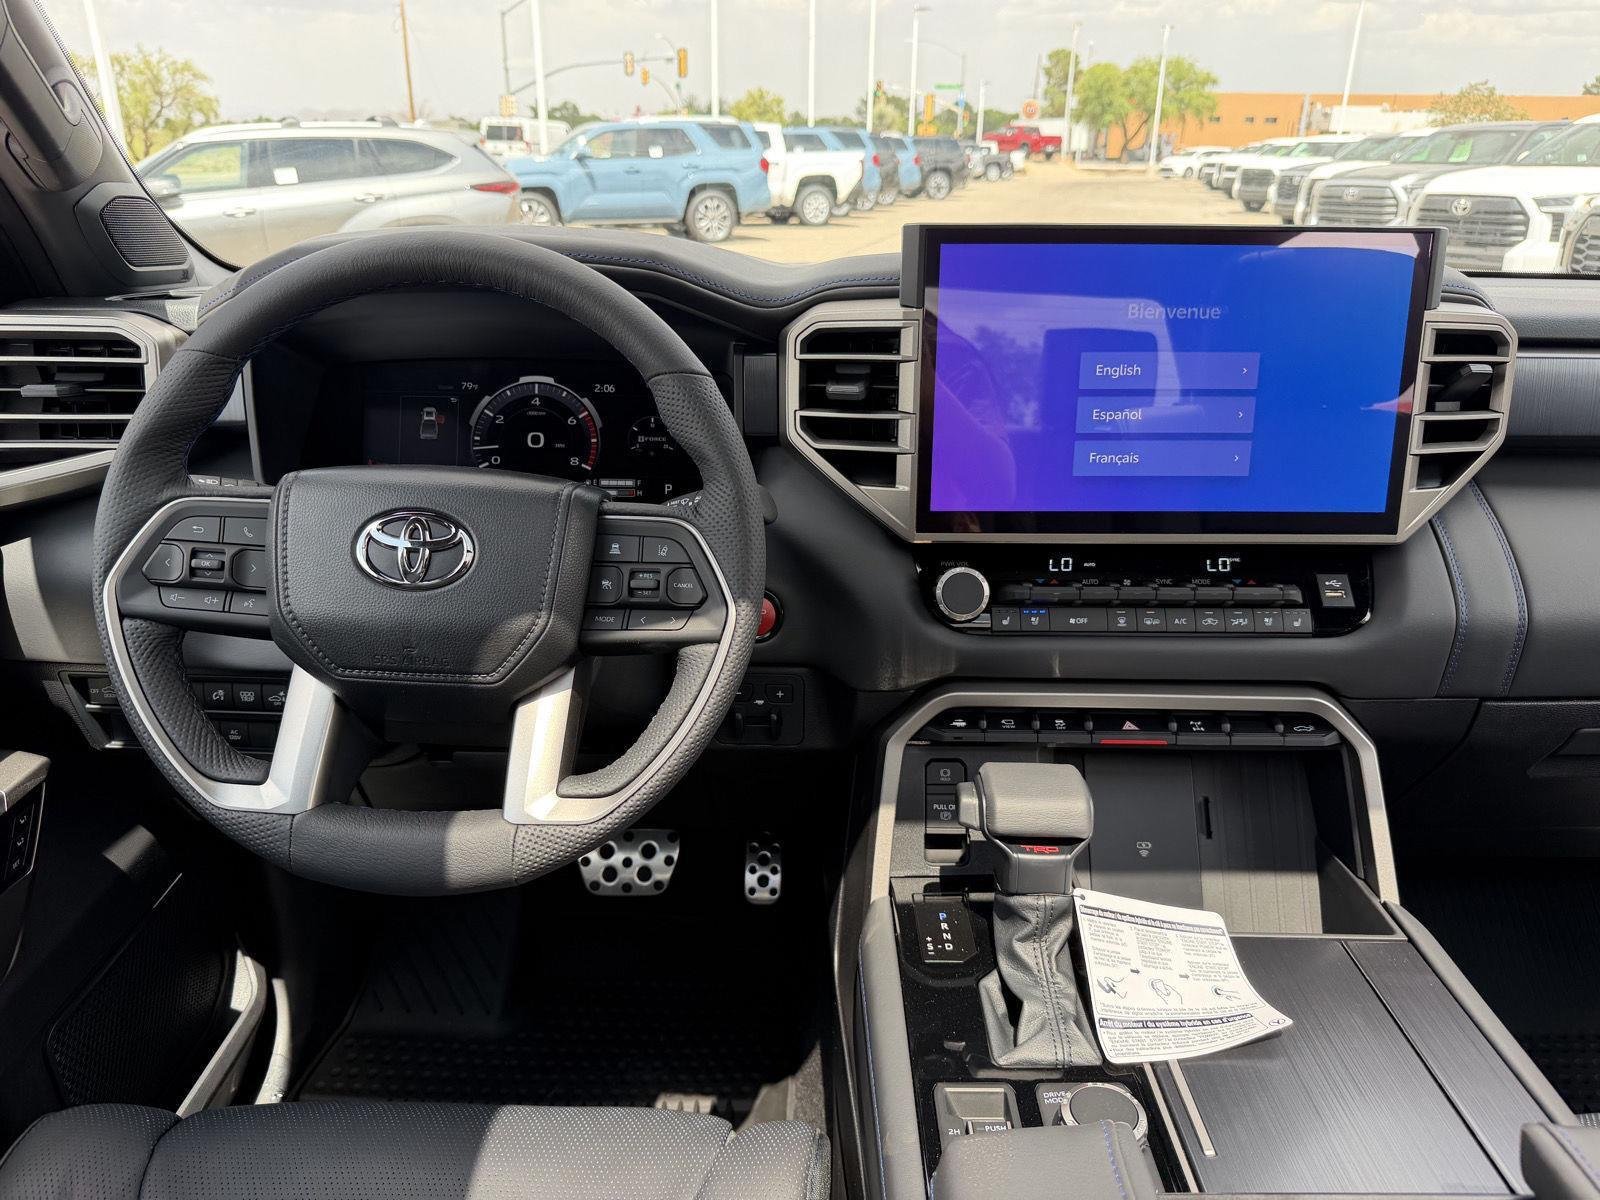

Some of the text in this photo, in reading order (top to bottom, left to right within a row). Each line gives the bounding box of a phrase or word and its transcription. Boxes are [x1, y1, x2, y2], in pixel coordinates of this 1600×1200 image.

[1128, 303, 1221, 320] Bienvenue
[1096, 364, 1141, 378] English
[594, 384, 616, 393] 2:06
[531, 398, 541, 406] 4
[495, 416, 504, 424] 2
[568, 416, 576, 424] 6
[1092, 408, 1142, 422] Español
[527, 432, 544, 448] 0
[491, 456, 500, 464] 0
[569, 457, 579, 466] 8
[1089, 452, 1140, 465] Français
[664, 484, 672, 495] P
[1048, 558, 1072, 572] LO
[1206, 558, 1230, 572] LO
[1020, 845, 1060, 854] TRD
[938, 912, 947, 921] P
